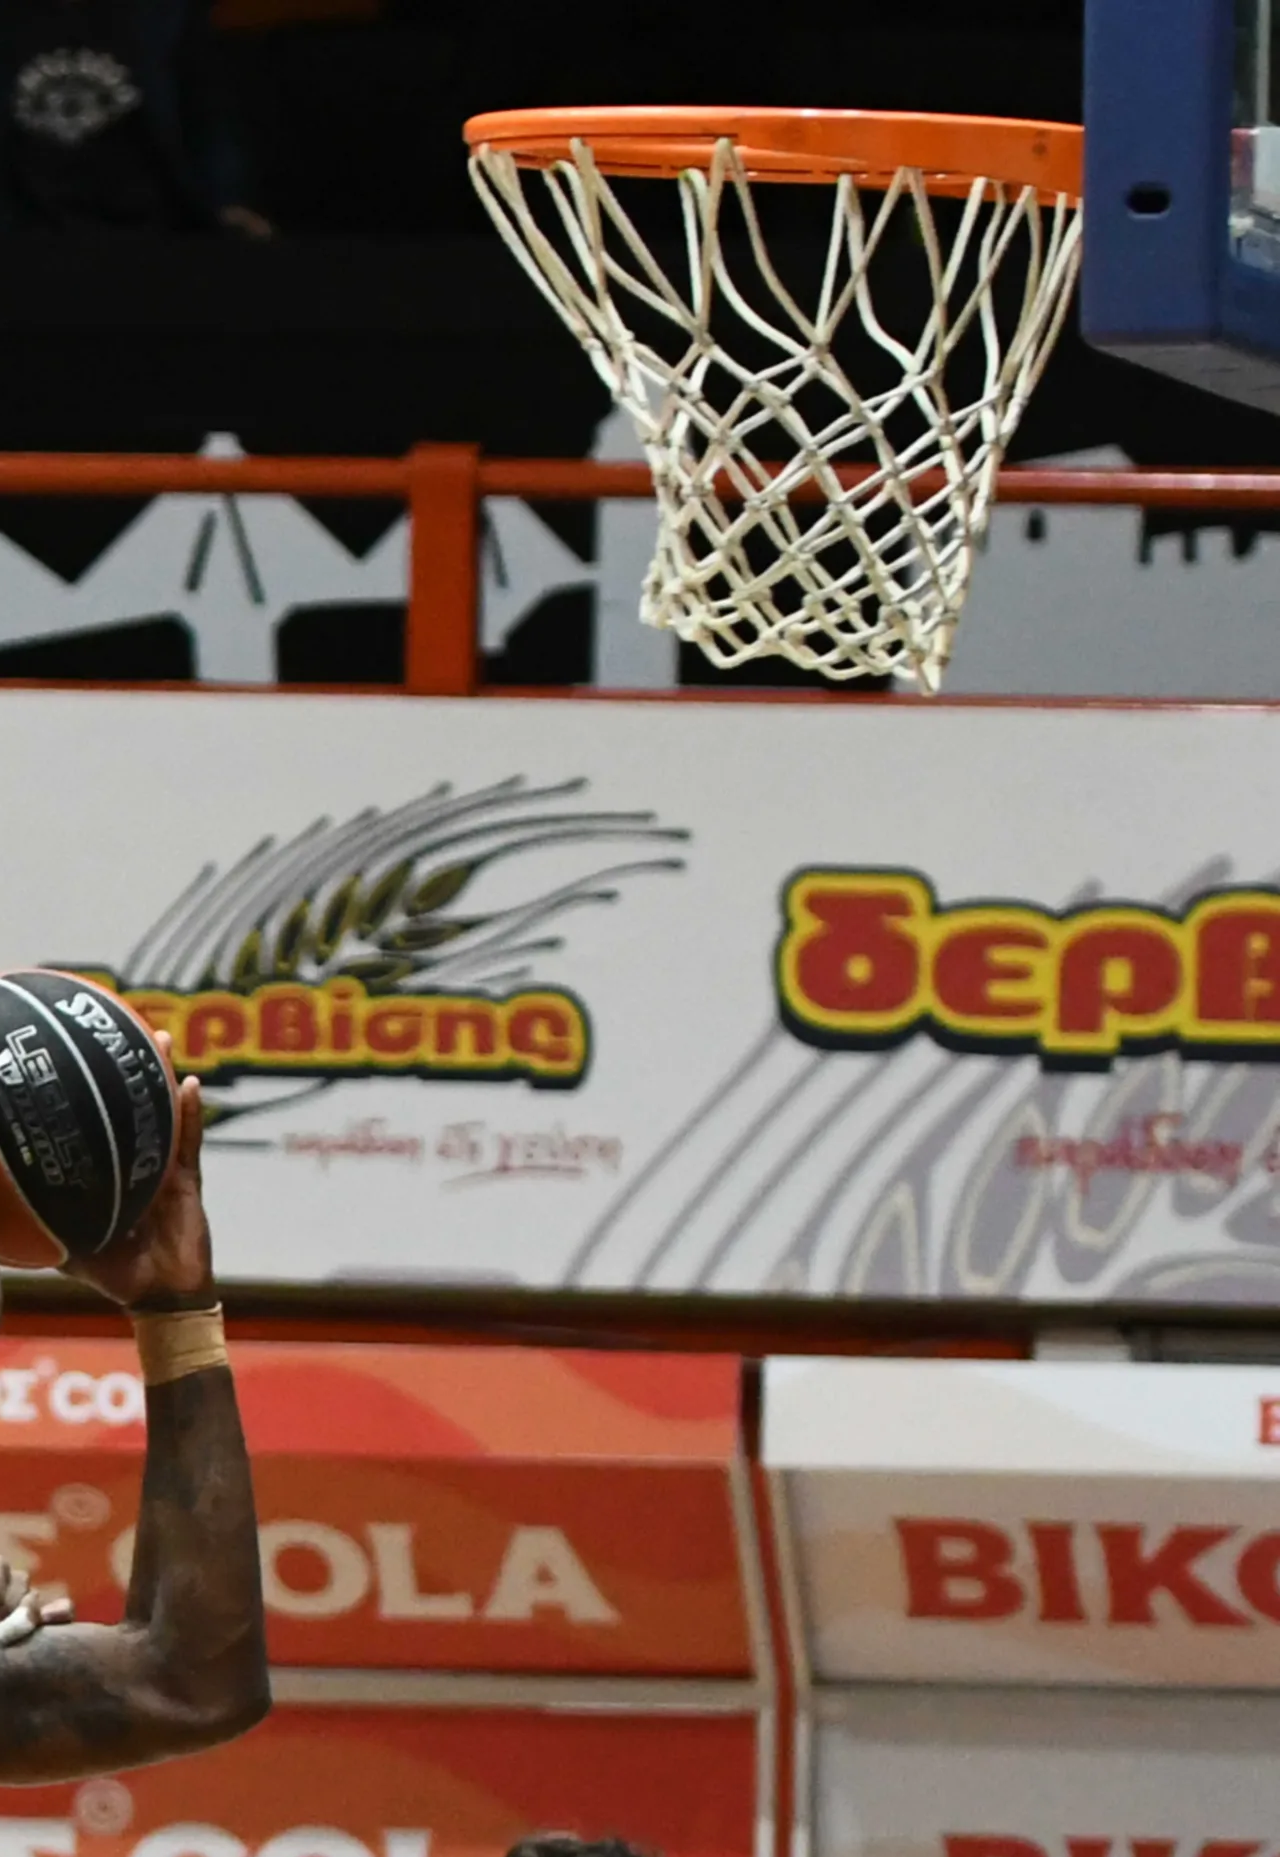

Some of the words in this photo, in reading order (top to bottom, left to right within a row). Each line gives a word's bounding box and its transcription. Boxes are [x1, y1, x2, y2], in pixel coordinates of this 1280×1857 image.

[780, 873, 1280, 1062] δερβ
[54, 992, 161, 1190] SPALDING
[50, 1370, 145, 1426] CO
[110, 1517, 621, 1627] OLA
